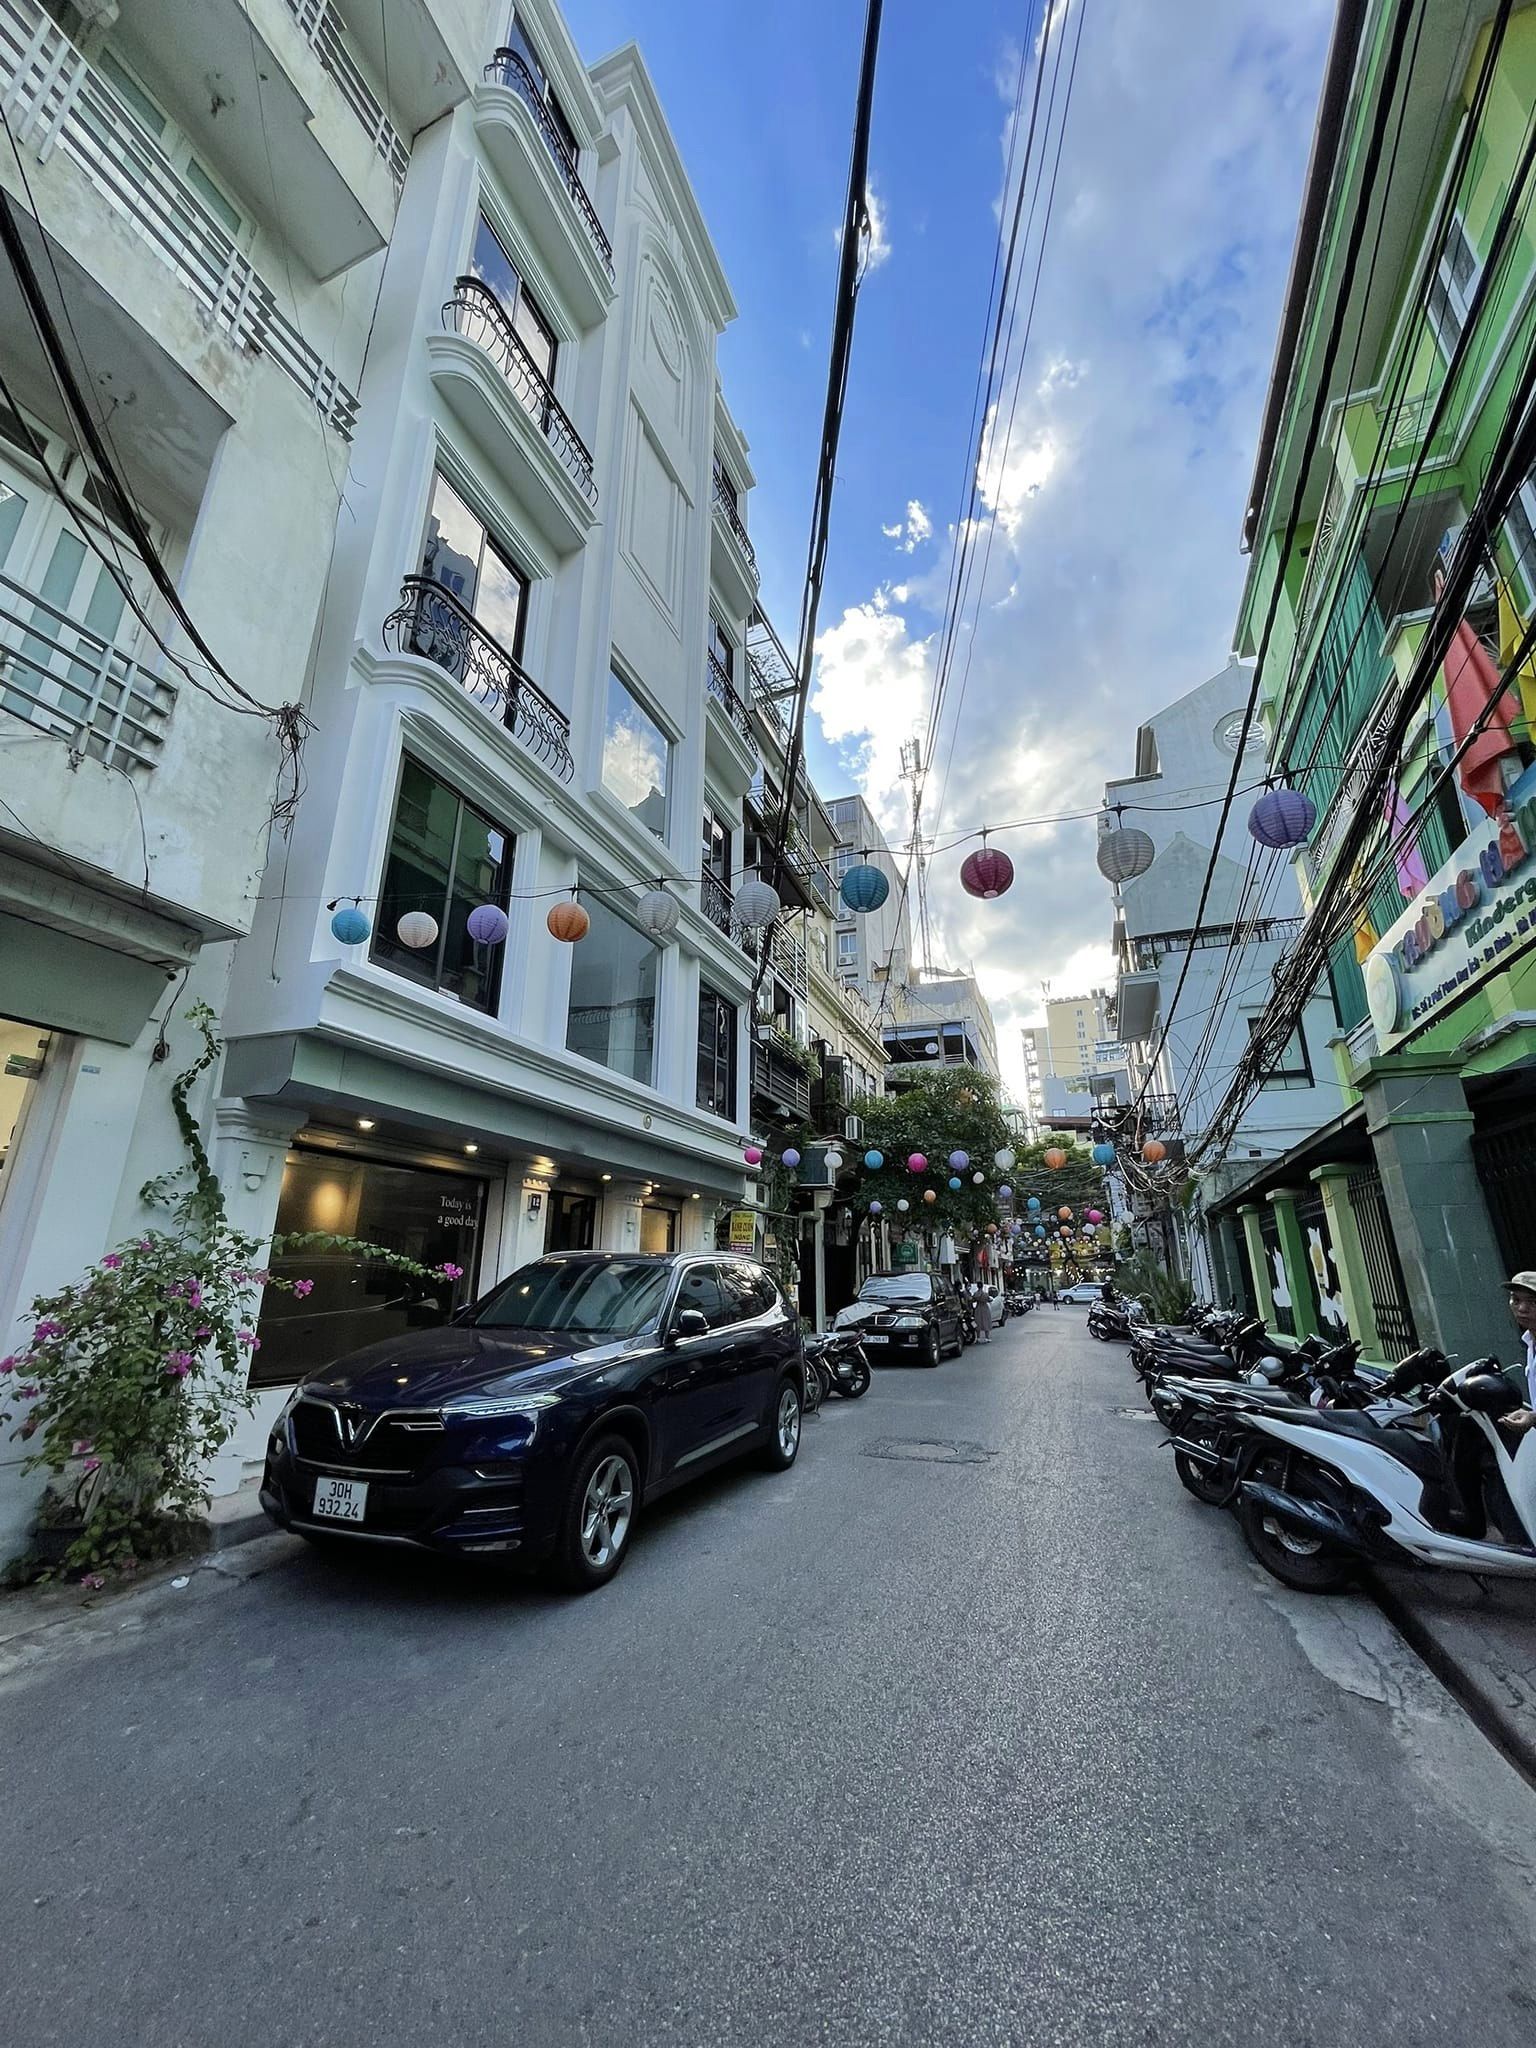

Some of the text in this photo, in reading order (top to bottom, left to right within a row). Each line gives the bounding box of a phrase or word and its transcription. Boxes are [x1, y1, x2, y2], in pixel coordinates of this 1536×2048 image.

[440, 1196, 472, 1212] Today is
[437, 1215, 443, 1223] a
[444, 1214, 464, 1227] good
[329, 1481, 353, 1499] 30H
[318, 1497, 359, 1519] 932.24
